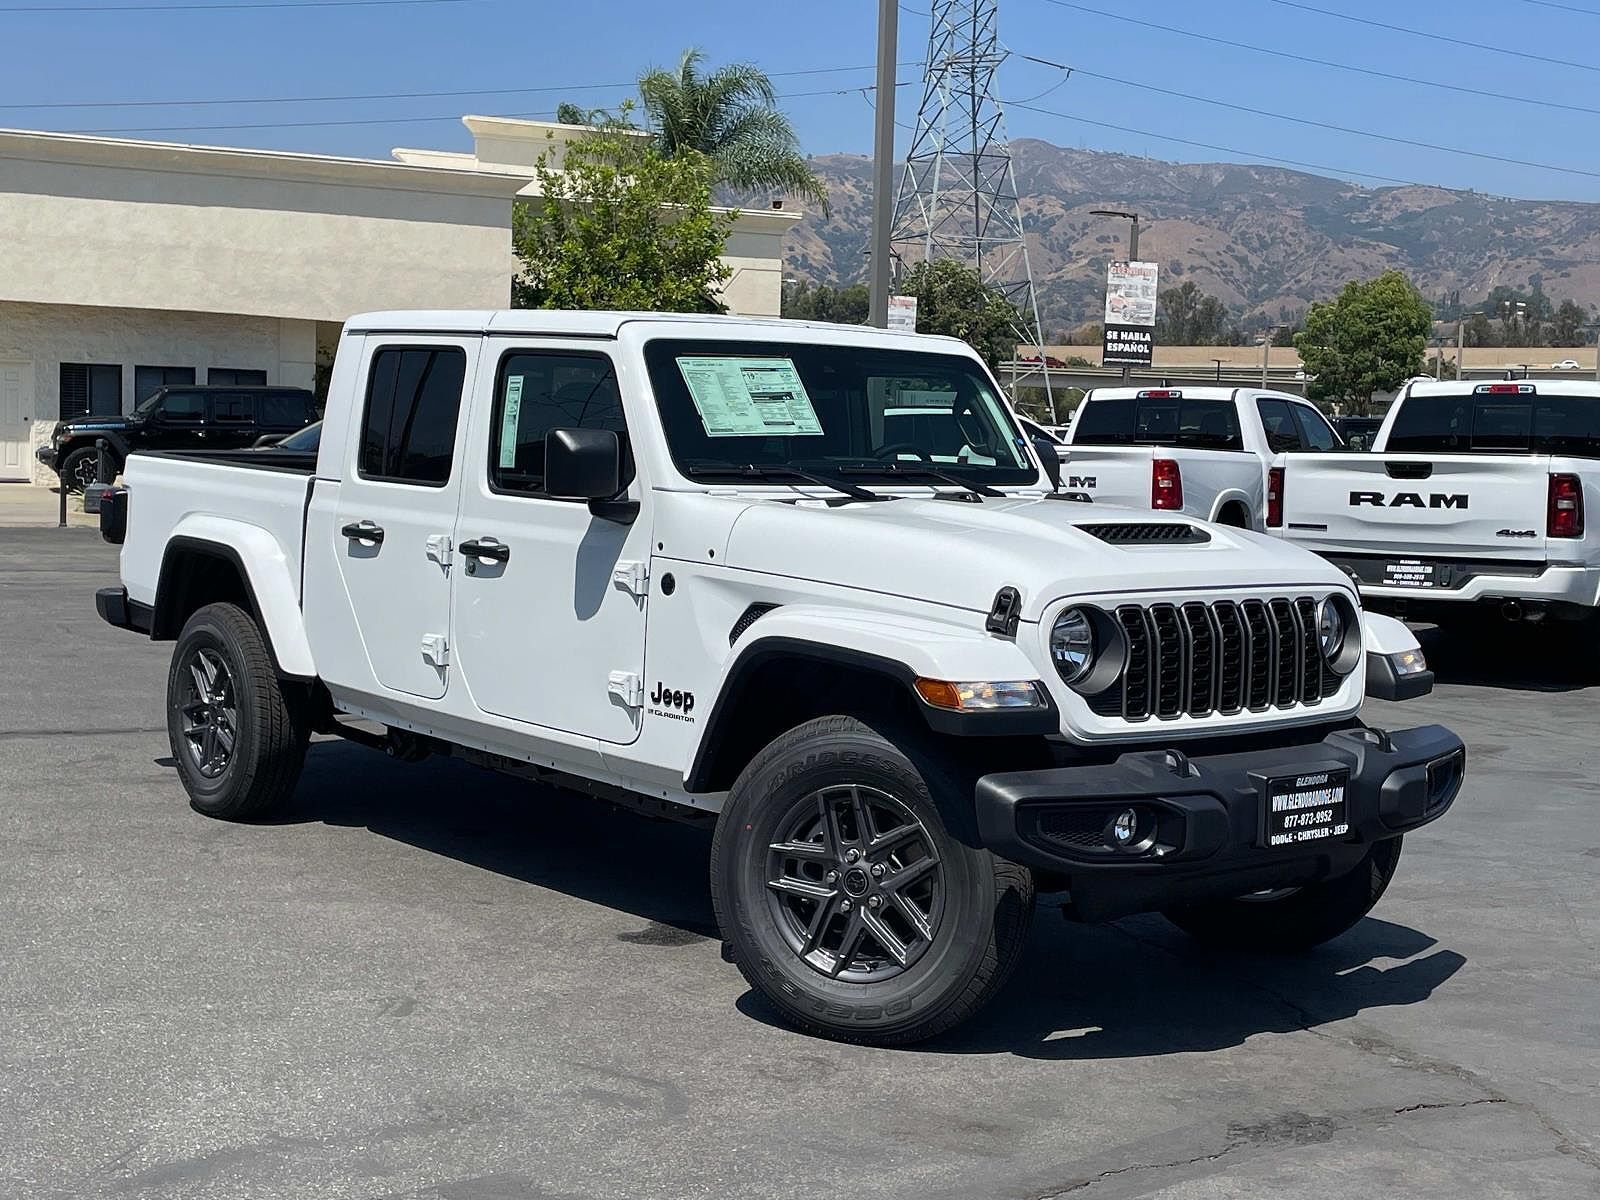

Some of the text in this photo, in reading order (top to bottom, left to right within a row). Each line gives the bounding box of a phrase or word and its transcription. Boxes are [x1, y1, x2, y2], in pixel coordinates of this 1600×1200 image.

[1106, 330, 1151, 342] SE HABLA
[1106, 341, 1150, 353] ESPAÑOL
[1349, 491, 1469, 509] RAM
[650, 681, 695, 715] Jeep
[654, 710, 695, 723] GLADIATOR
[1295, 774, 1329, 787] GLENDORA
[1284, 810, 1333, 829] 877-873-9952
[1271, 824, 1349, 846] DODGE CHRYSLER JEEP
